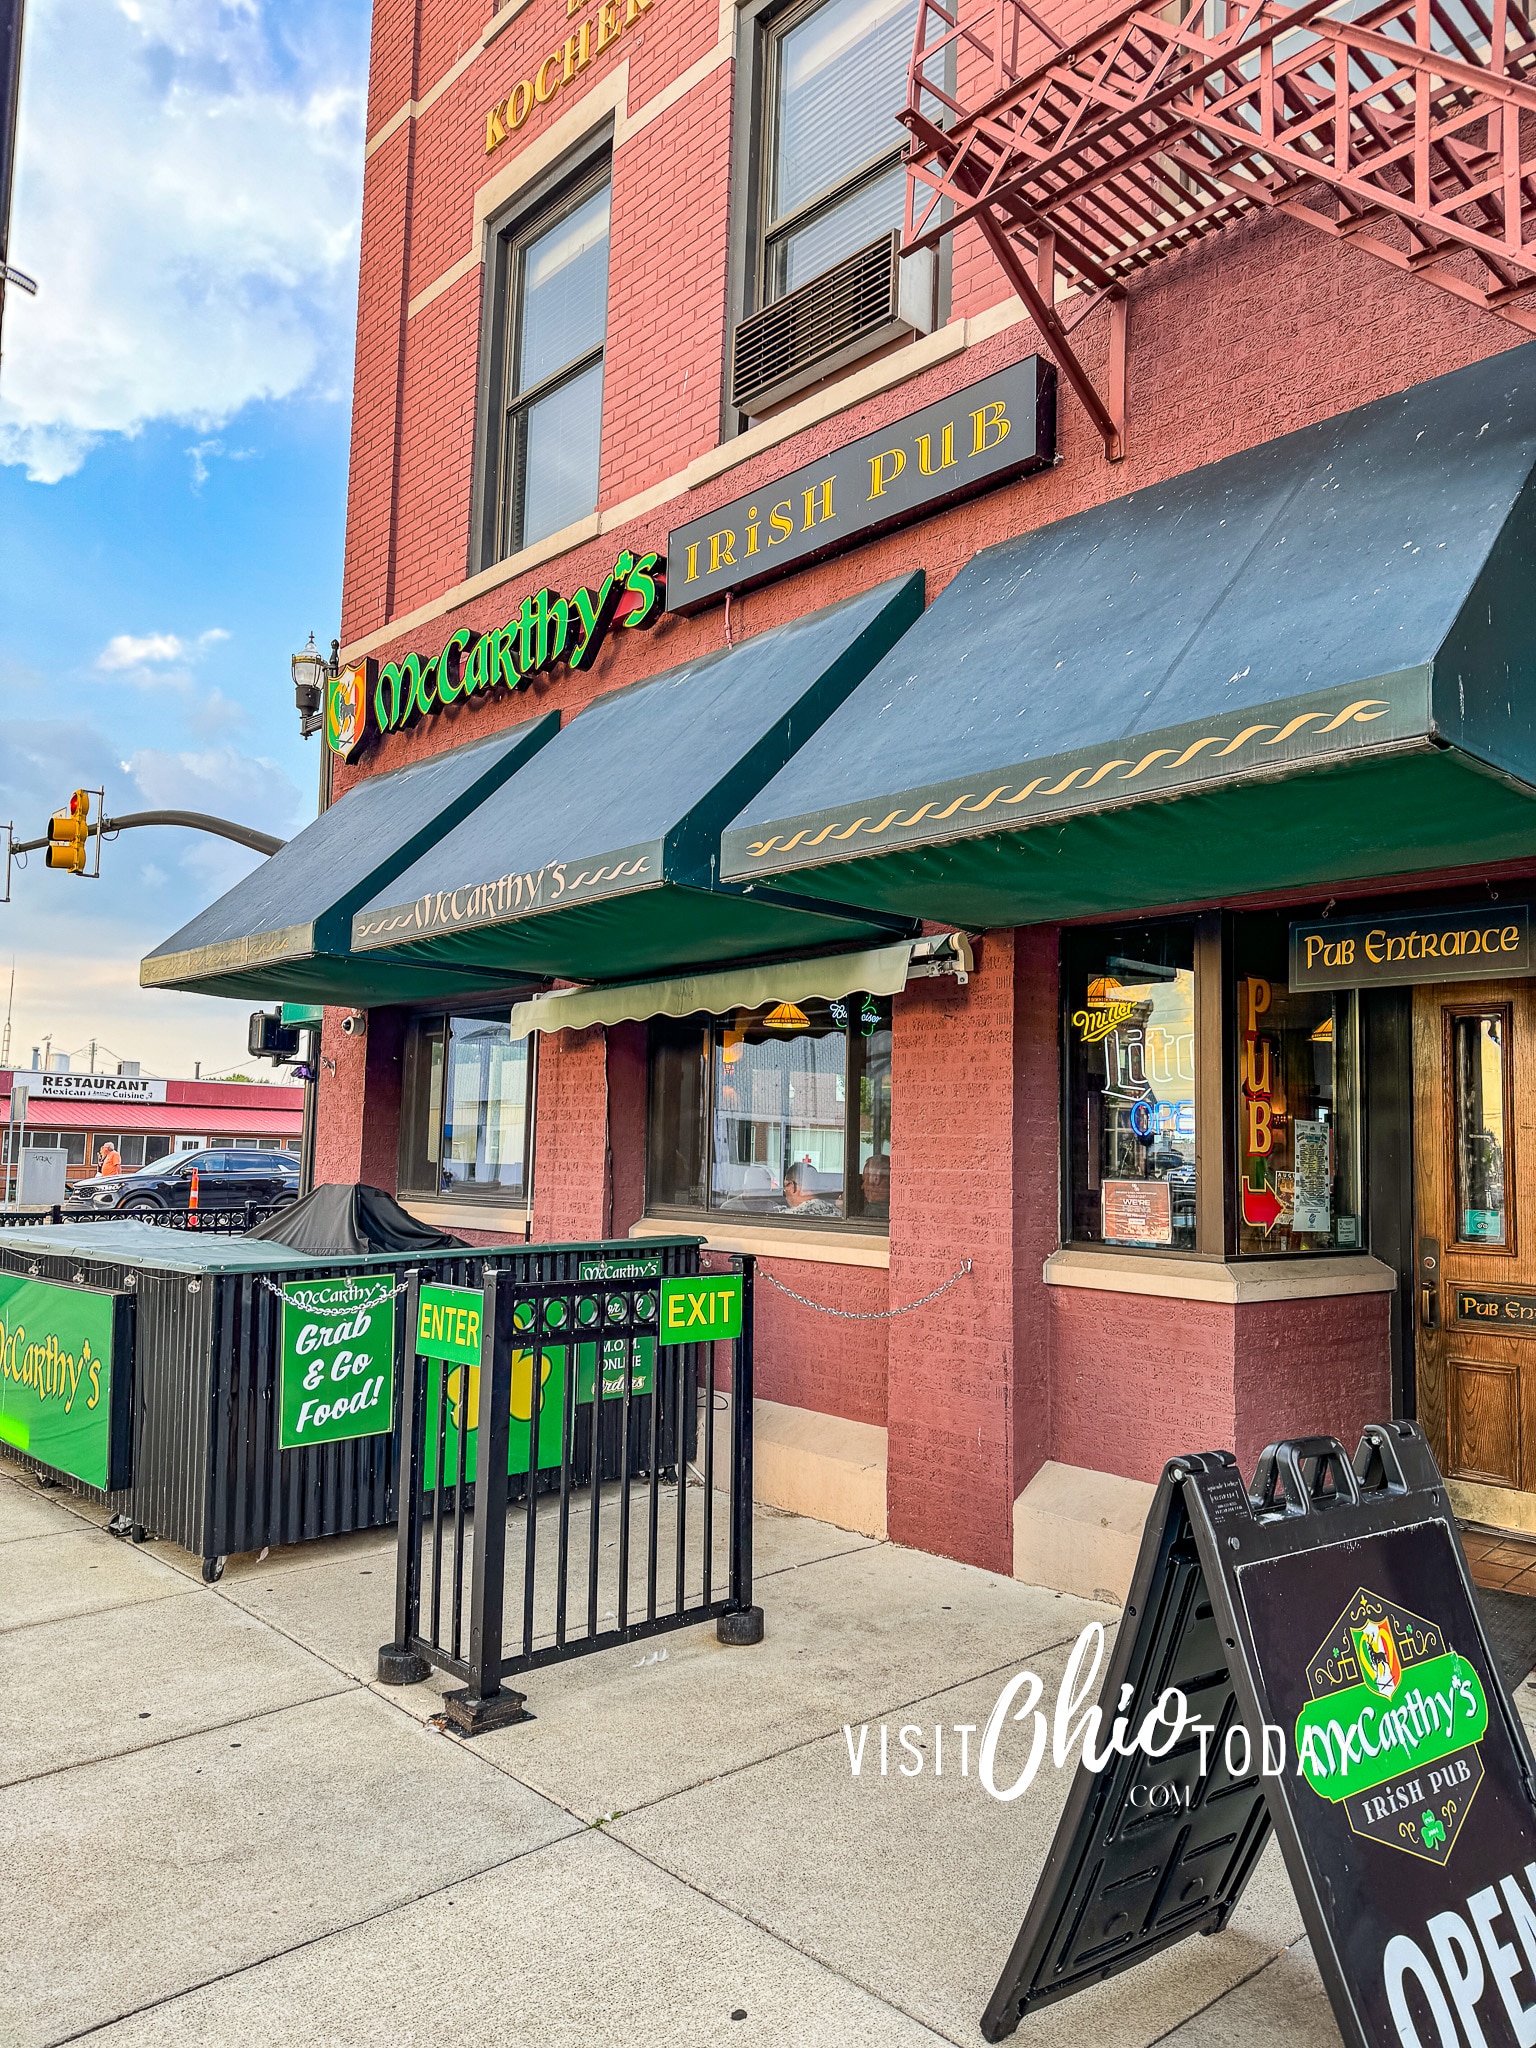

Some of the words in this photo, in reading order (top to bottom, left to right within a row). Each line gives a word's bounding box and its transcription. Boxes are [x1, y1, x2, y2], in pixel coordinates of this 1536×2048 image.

[867, 401, 1012, 501] PUB
[375, 550, 658, 734] McCarthy's
[414, 860, 568, 930] McCarthy's
[1072, 1002, 1138, 1036] Miller
[42, 1076, 149, 1091] RESTAURANT
[1246, 976, 1273, 1156] PUB
[42, 1087, 86, 1097] Mexican
[113, 1090, 145, 1099] Cuisine
[294, 1283, 387, 1305] McCarthy's
[668, 1291, 735, 1328] EXIT
[295, 1309, 372, 1355] Grab
[420, 1303, 479, 1349] ENTER
[0, 1321, 102, 1415] cCarthy's
[302, 1359, 325, 1390] &
[331, 1350, 373, 1382] Go
[295, 1375, 385, 1433] Food!
[1427, 1759, 1472, 1795] PUB
